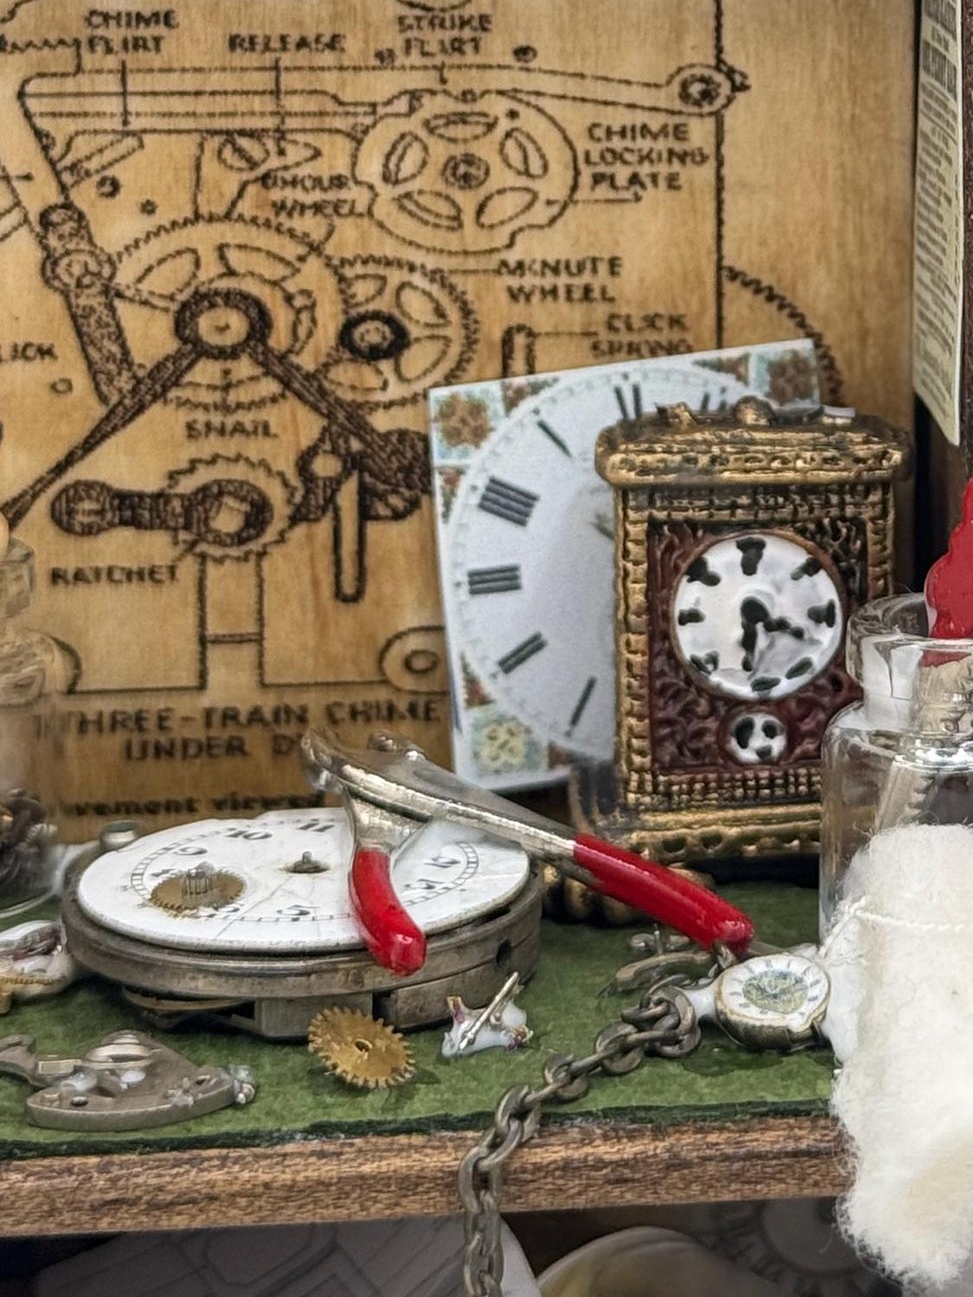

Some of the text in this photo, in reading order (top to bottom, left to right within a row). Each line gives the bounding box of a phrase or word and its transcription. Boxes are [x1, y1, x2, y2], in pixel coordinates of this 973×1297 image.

[85, 8, 180, 30] CHIME
[228, 33, 347, 53] RELEASE
[587, 122, 690, 143] CHIME
[584, 146, 711, 167] LOCKING
[590, 171, 683, 192] PLATE
[498, 255, 623, 277] MINUTE
[506, 283, 617, 304] WHEEL
[185, 417, 279, 440] SNAIL
[50, 564, 178, 587] RATCHET
[325, 698, 442, 726] CHIME
[124, 734, 248, 761] UNDER
